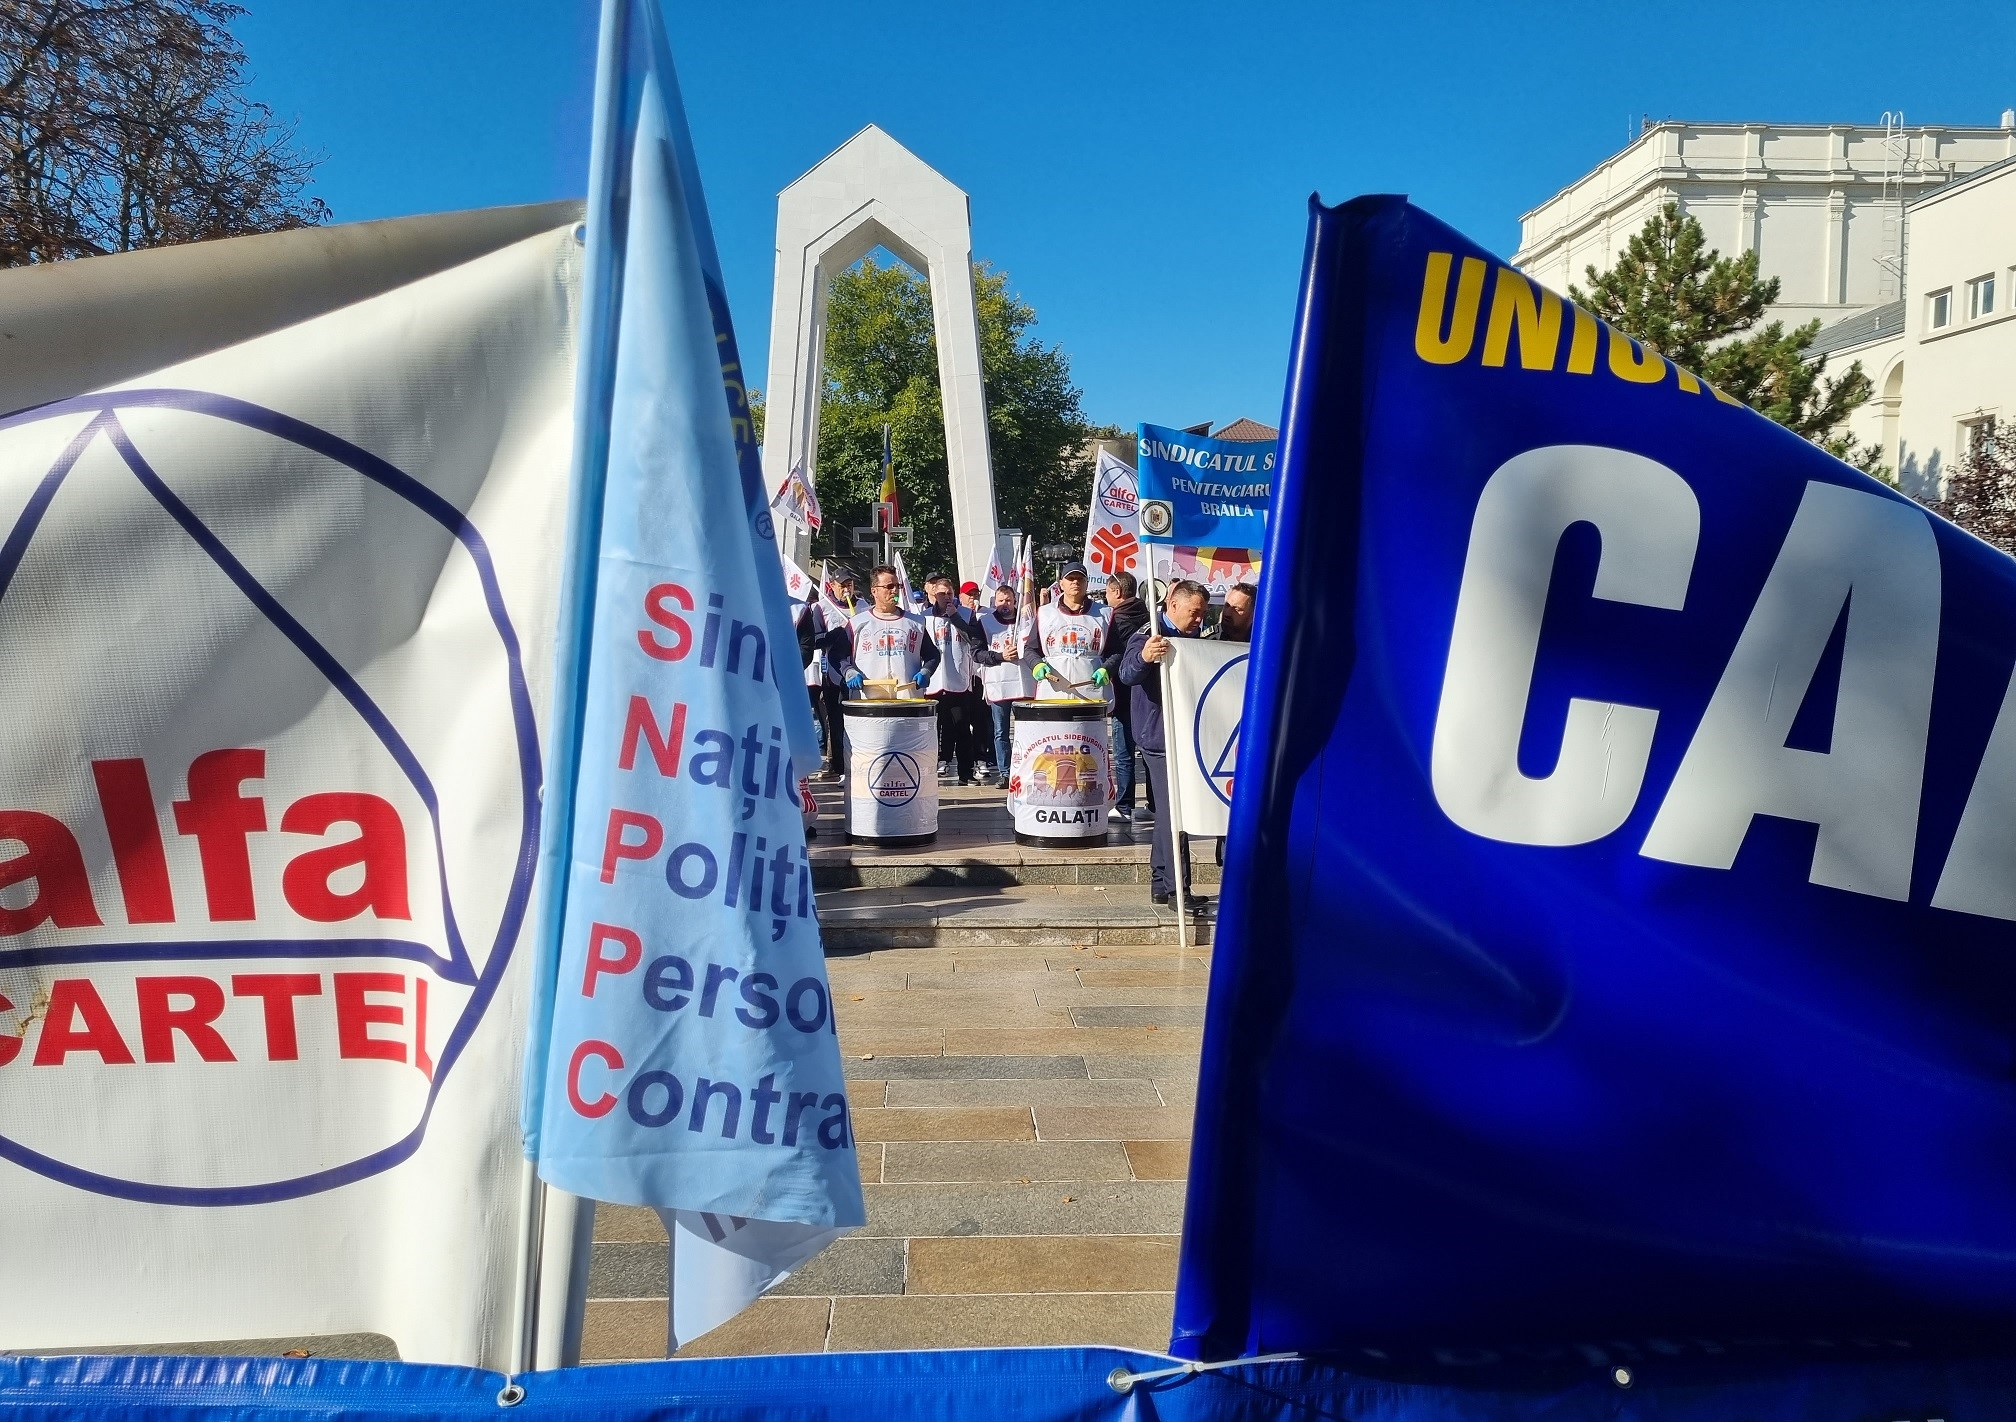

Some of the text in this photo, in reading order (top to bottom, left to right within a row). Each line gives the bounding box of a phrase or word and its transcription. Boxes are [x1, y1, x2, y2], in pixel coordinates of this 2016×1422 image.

[1140, 437, 1258, 472] SINDICATUL
[1103, 500, 1136, 512] CARTEL
[1109, 486, 1136, 502] alfa
[1201, 500, 1254, 517] BRĂILA
[637, 582, 779, 691] Sin
[1023, 735, 1062, 759] SINDICATUL
[1035, 809, 1099, 828] GALAȚI
[600, 808, 824, 947] Poliți
[581, 921, 838, 1036] Perso
[566, 1039, 856, 1152] Contra
